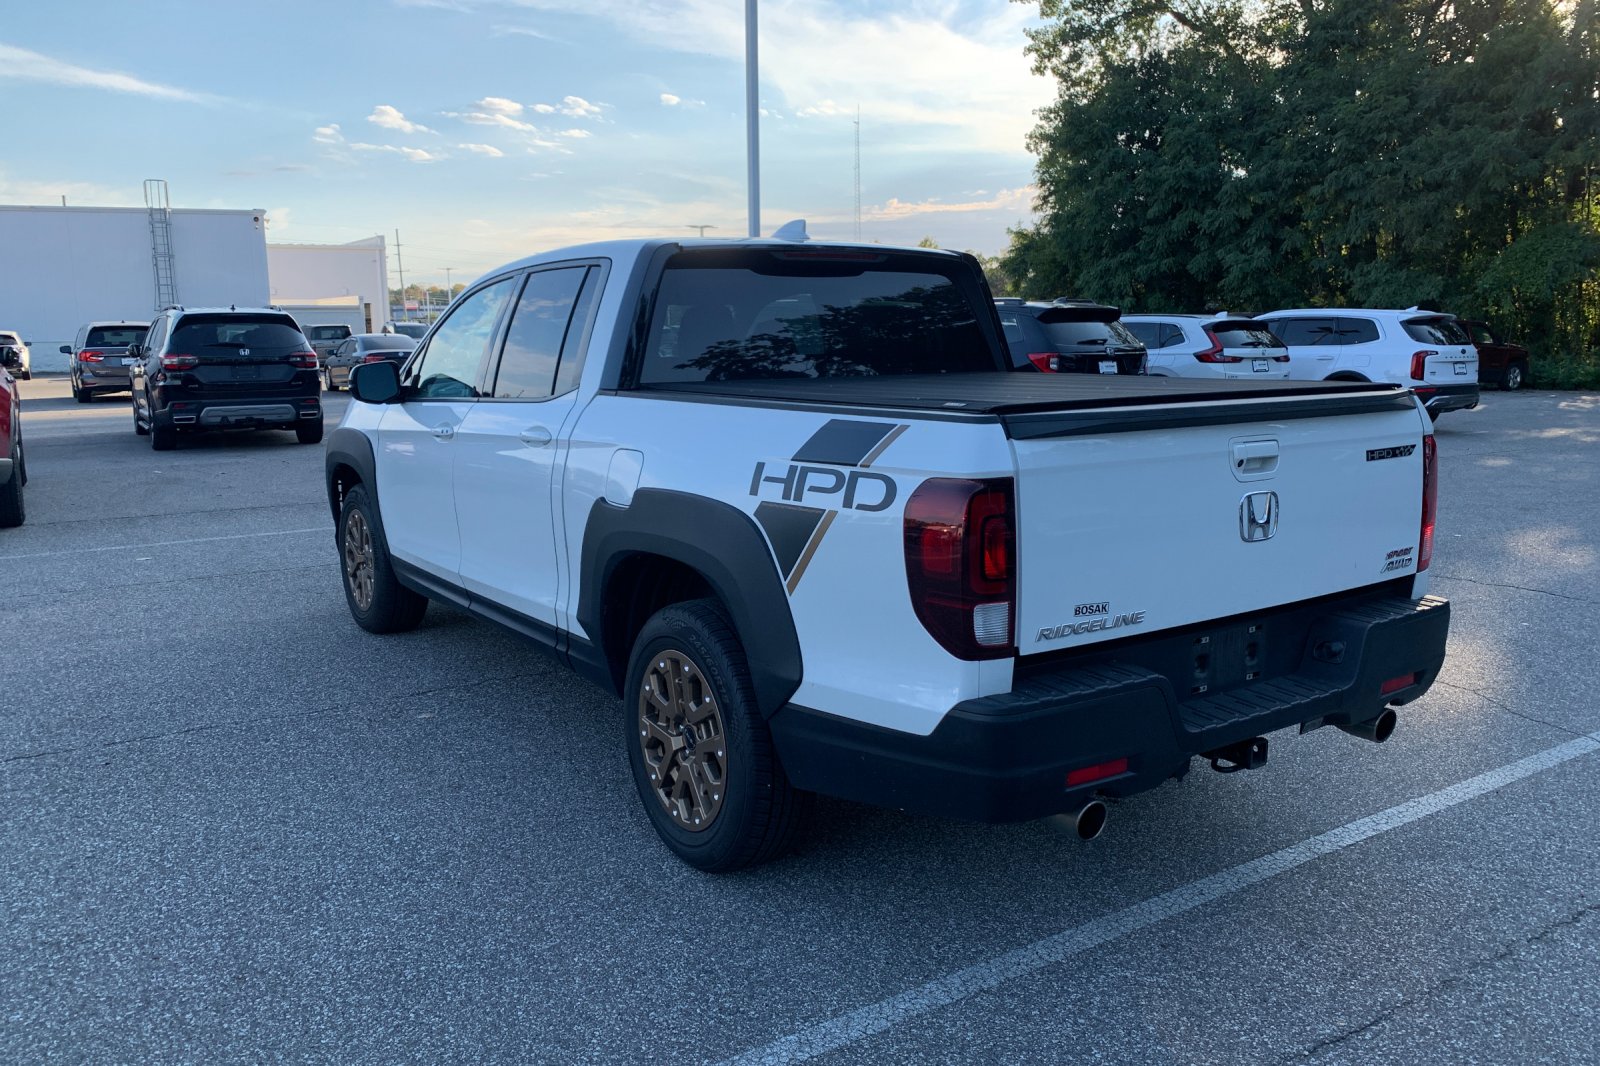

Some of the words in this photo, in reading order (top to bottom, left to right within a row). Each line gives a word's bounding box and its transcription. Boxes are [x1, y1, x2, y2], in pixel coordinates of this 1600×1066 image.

[1368, 449, 1393, 461] HPD
[749, 461, 898, 512] HPD
[1074, 603, 1109, 616] BOSAK
[1035, 610, 1147, 642] RIDGELINE
